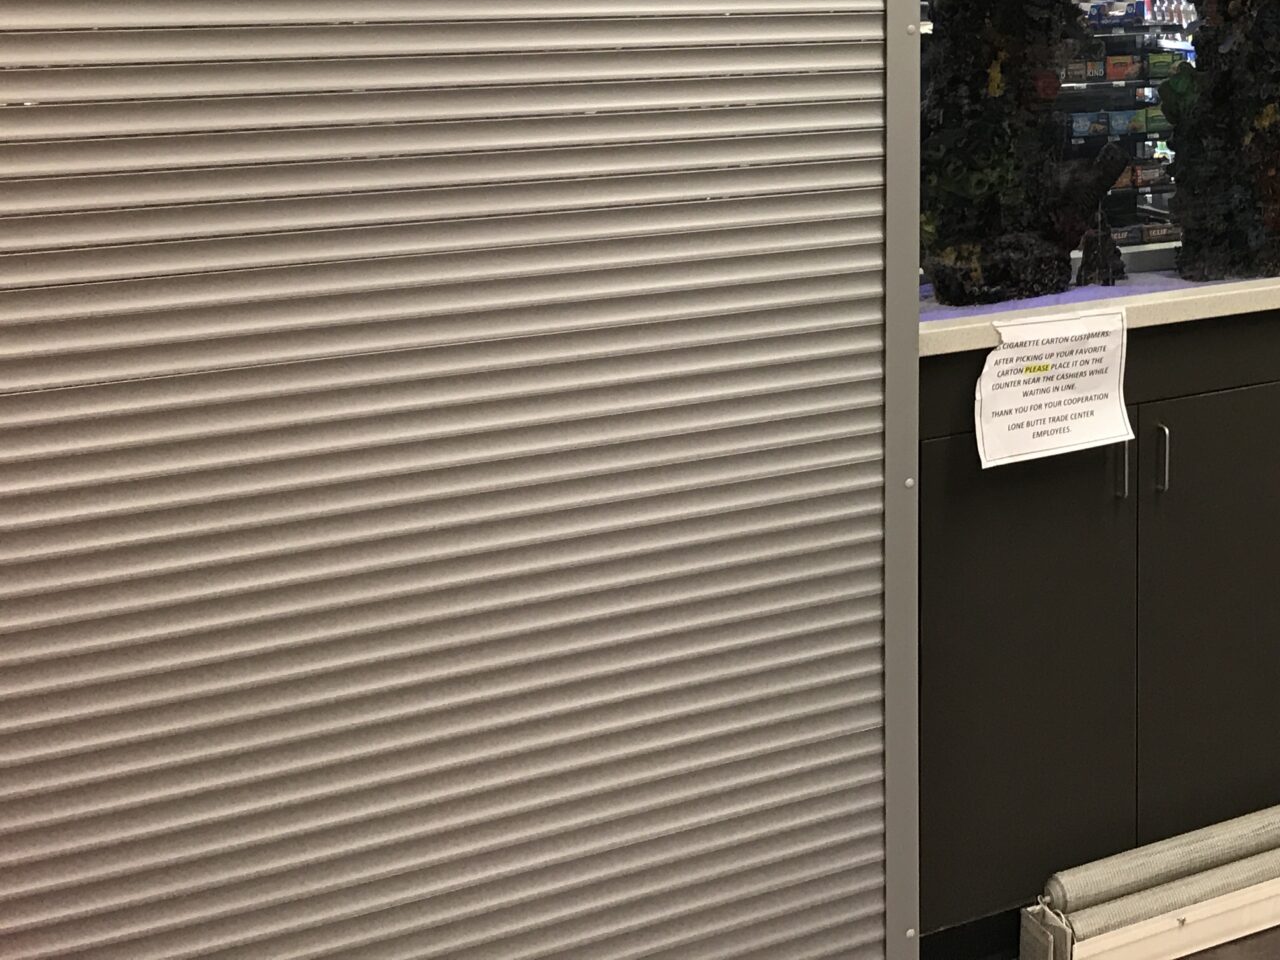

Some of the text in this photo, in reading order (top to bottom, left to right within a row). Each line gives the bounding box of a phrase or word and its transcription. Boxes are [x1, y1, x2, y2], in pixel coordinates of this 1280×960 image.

[1002, 340, 1040, 351] CIGARETTE
[1041, 336, 1070, 346] CARTON
[993, 345, 1107, 367] AFTER PICKING UP YOUR FAVORITE
[996, 356, 1104, 378] CARTON PLEASE PLACE IT ON THE
[991, 366, 1109, 391] COUNTER NEAR THE CASHIERS WHILE
[1022, 386, 1051, 398] WAITING
[1052, 385, 1060, 393] IN
[991, 392, 1109, 419] THANK YOU FOR YOUR COOPERATION
[1007, 409, 1095, 432] LONE BUTTE TRADE CENTER
